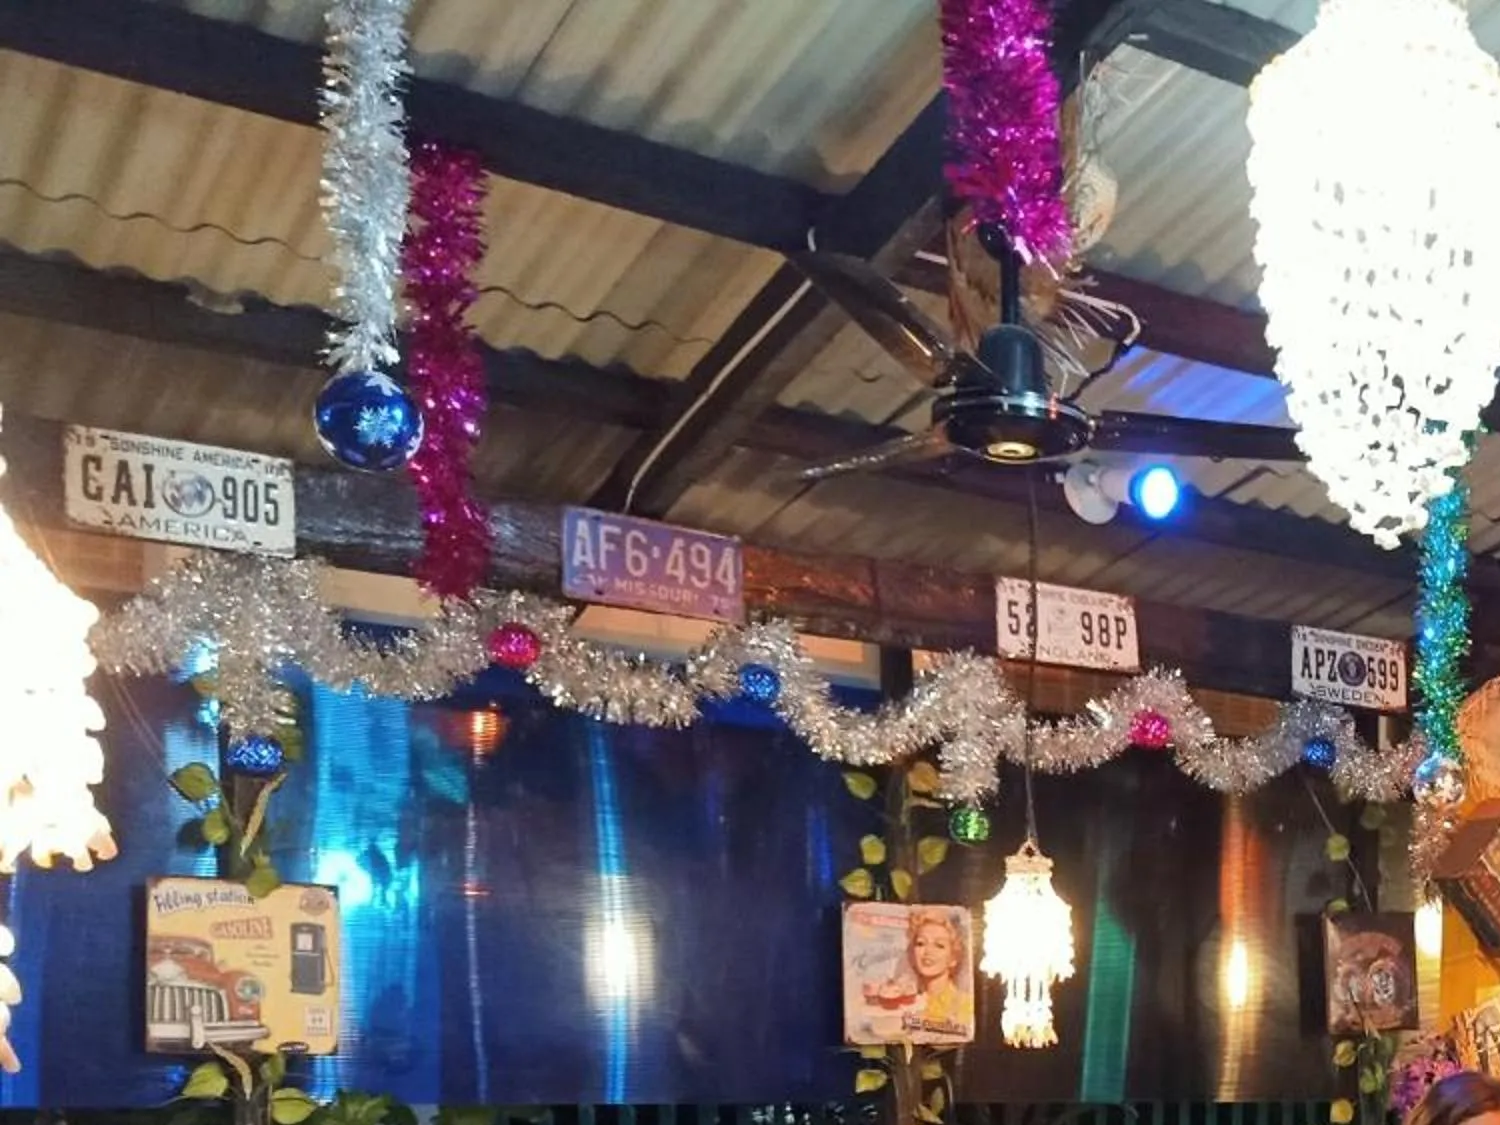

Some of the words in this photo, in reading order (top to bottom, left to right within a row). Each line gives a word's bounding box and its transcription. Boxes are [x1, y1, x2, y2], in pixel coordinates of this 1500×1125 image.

[81, 453, 156, 509] CAI
[221, 475, 280, 527] 905
[118, 511, 250, 543] AMERICA
[1081, 611, 1127, 650] 98P
[1036, 644, 1113, 662] NGLAND
[1301, 645, 1338, 683] APZ
[1367, 656, 1399, 692] 599
[1317, 684, 1385, 705] SWEDEN
